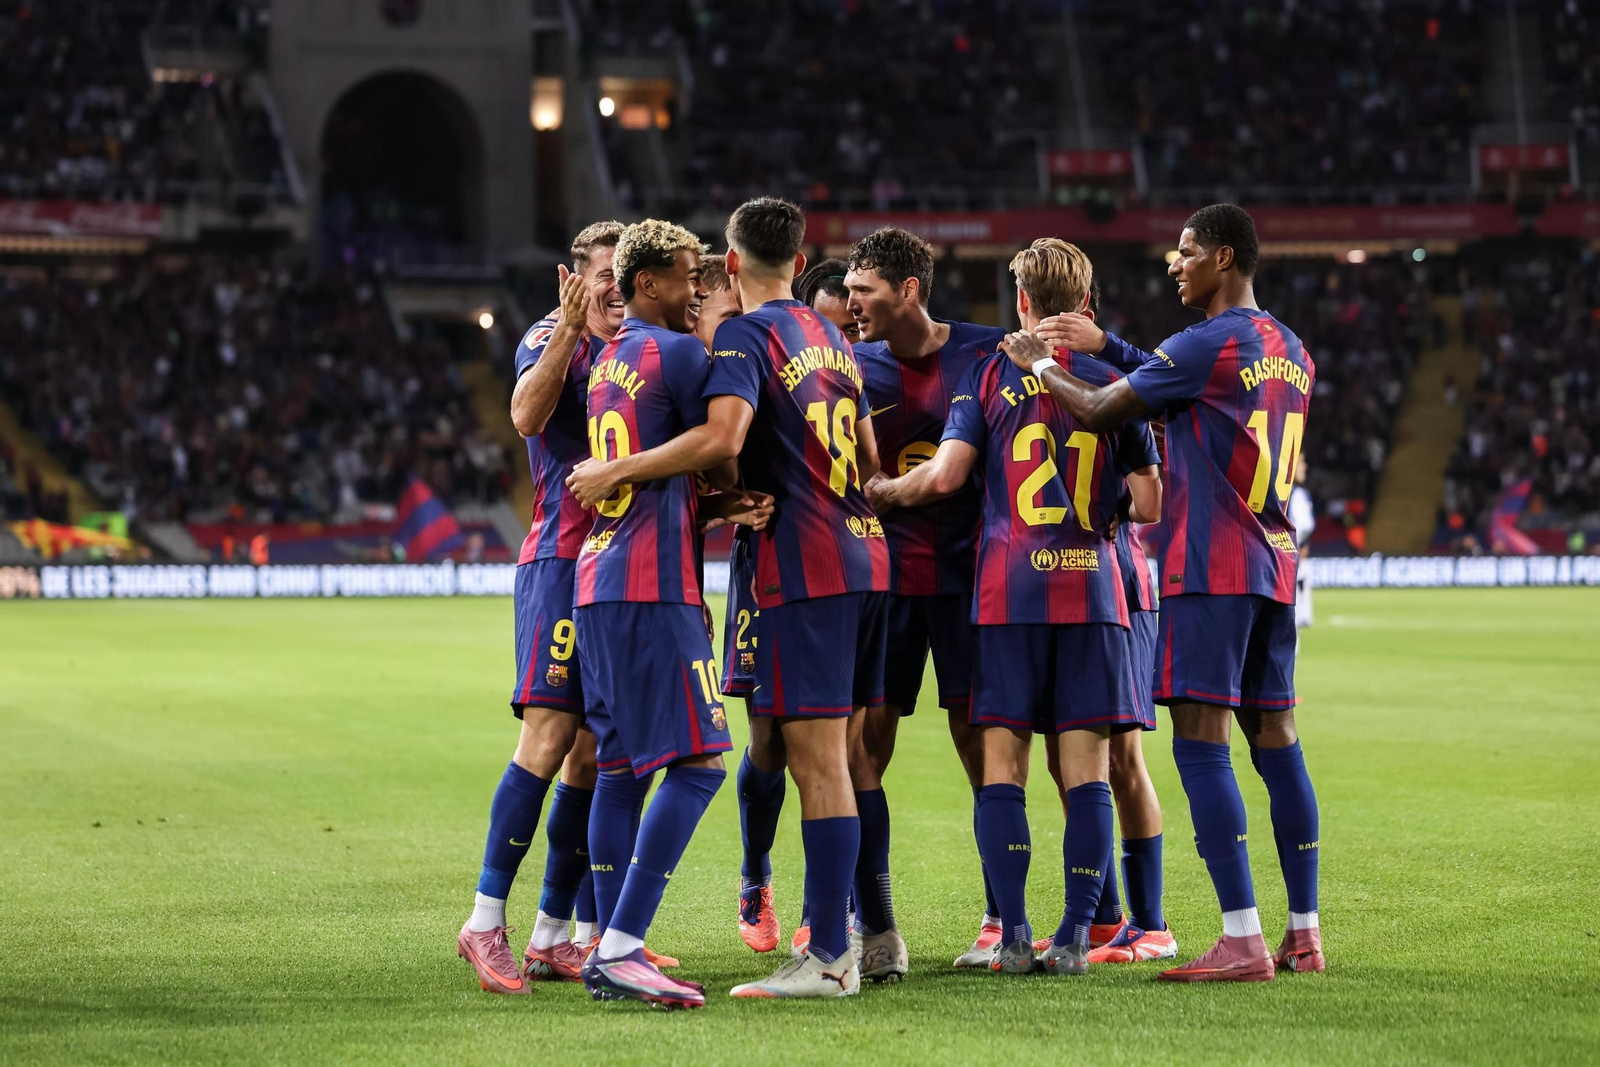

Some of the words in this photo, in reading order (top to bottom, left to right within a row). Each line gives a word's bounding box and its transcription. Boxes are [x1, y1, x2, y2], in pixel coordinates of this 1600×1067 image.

[778, 346, 824, 392] GERARD
[1239, 356, 1310, 396] RASHFORD
[1000, 385, 1025, 407] F.
[588, 410, 633, 518] 10
[806, 398, 861, 498] 18
[1247, 410, 1304, 516] 14
[1012, 422, 1099, 532] 21
[1060, 549, 1098, 559] UNHCR
[1061, 558, 1099, 567] ACNUR
[550, 619, 576, 661] 9
[692, 659, 723, 704] 10
[1071, 867, 1100, 877] BARÇA
